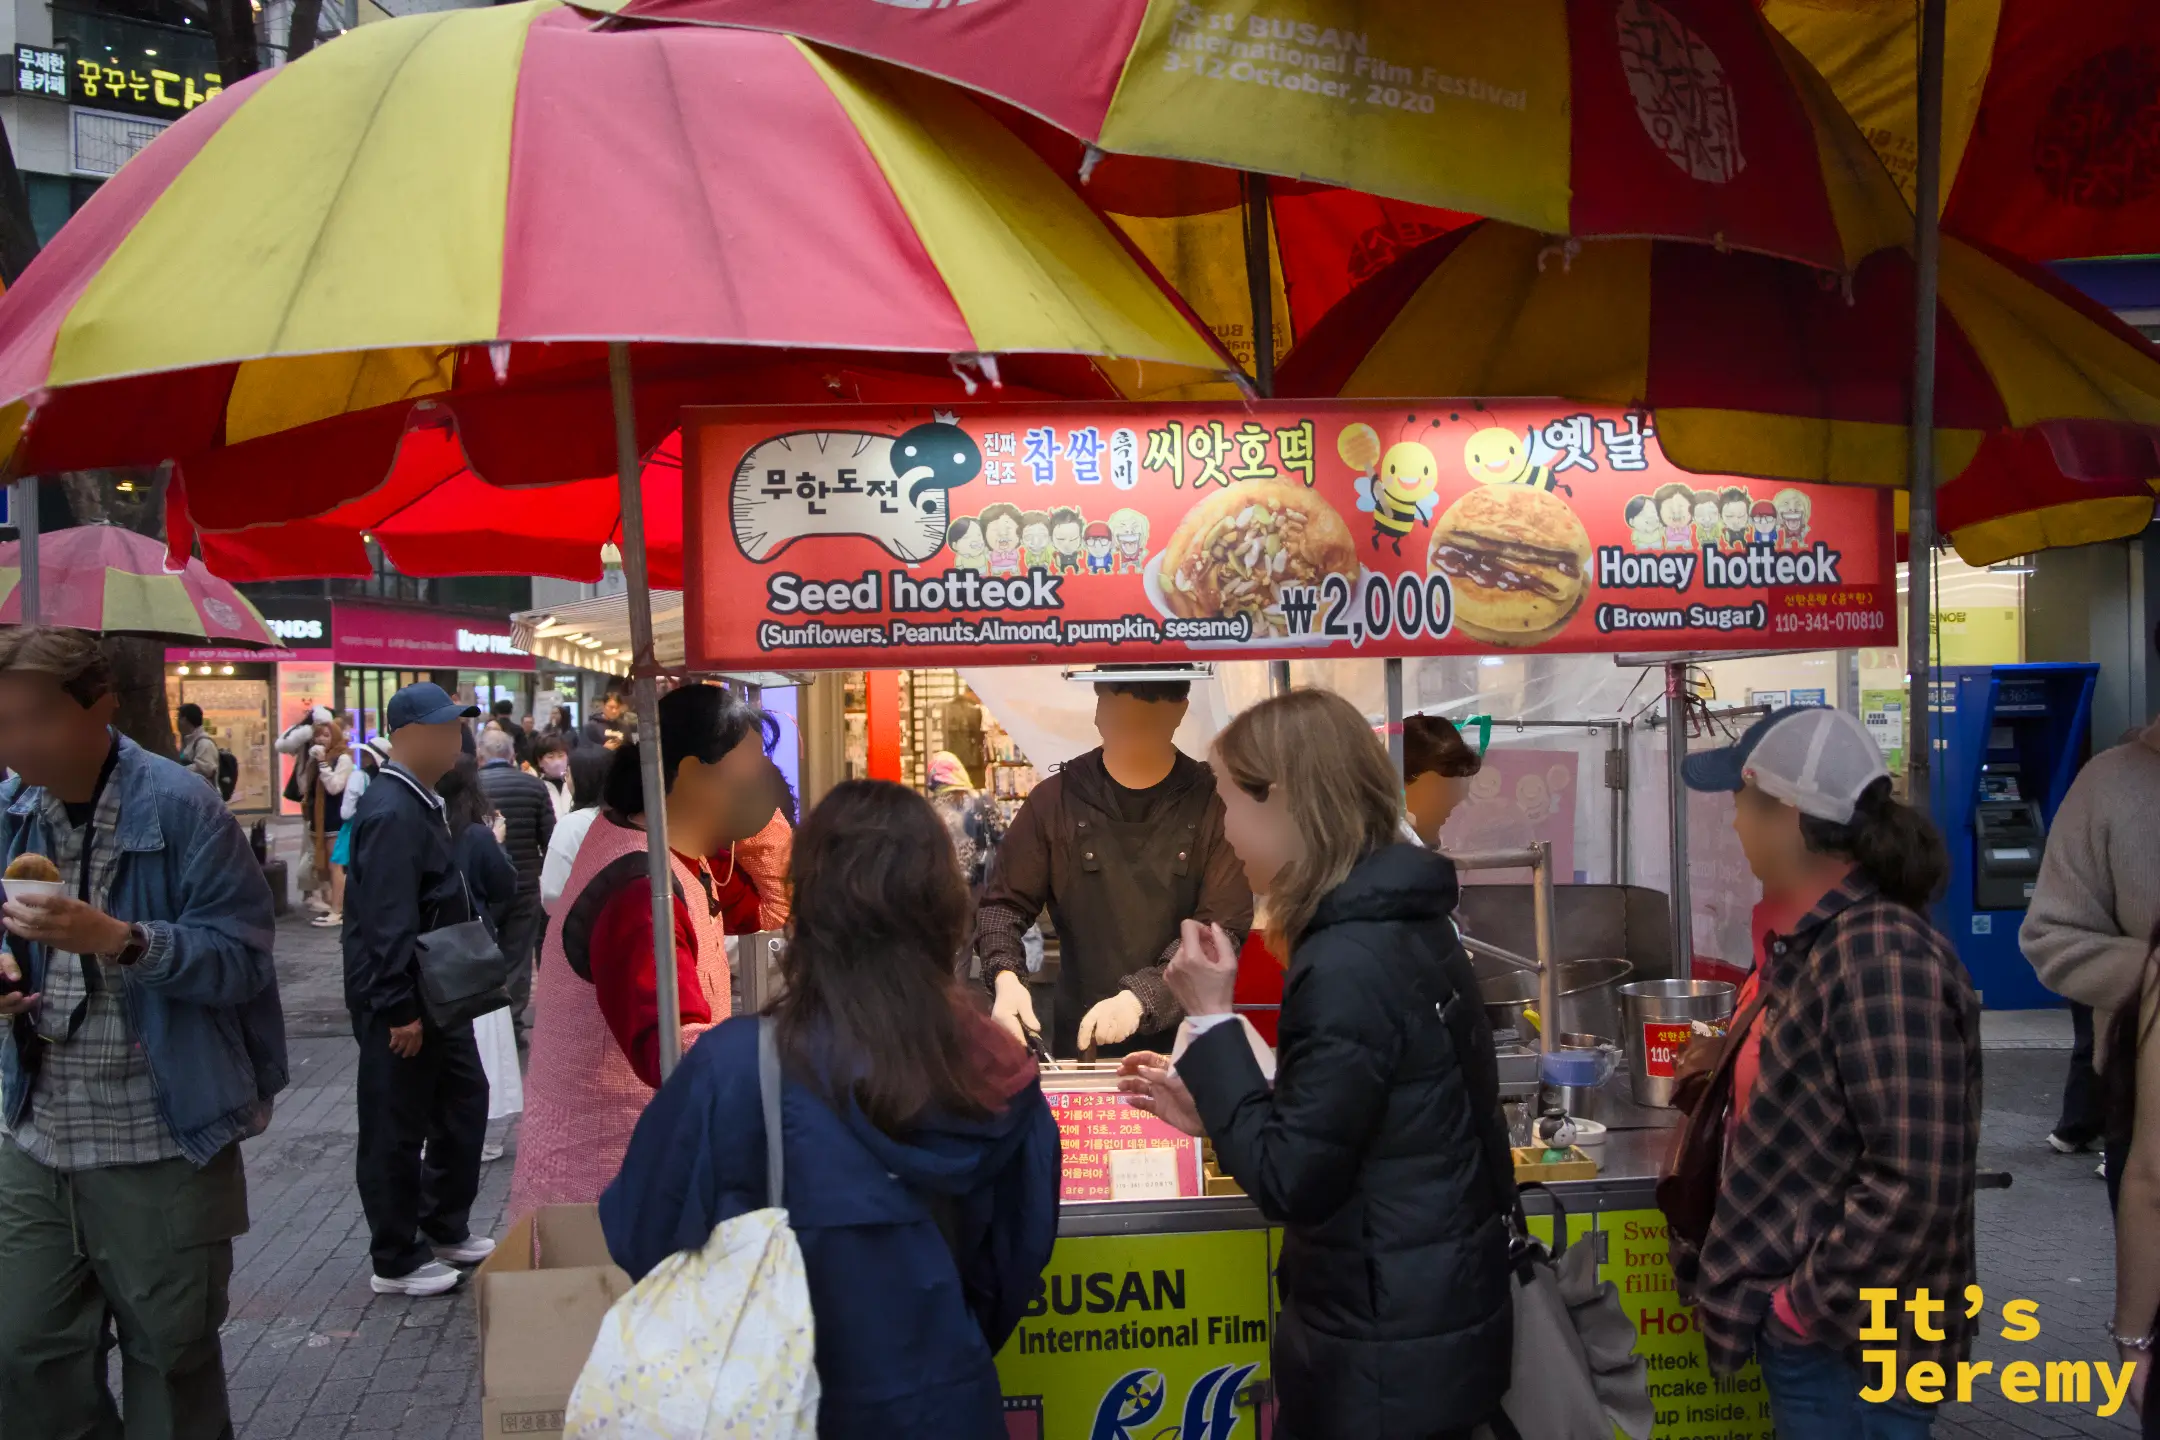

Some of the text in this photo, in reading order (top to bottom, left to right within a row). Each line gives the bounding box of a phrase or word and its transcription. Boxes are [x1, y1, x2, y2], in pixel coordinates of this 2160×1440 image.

[1247, 15, 1368, 55] BUSAN
[18, 47, 65, 74] 무제한
[1169, 22, 1528, 112] International Film Festival
[77, 59, 150, 102] 꿈꾸는
[1366, 84, 1435, 114] 2020
[983, 431, 1017, 457] 진짜
[1022, 419, 1317, 487] 찹쌀 흑미 씨앗호떡
[1543, 413, 1654, 471] 옛날
[984, 459, 1017, 486] 원조
[760, 467, 900, 515] 무한도전
[1600, 546, 1839, 588] Honey hotteok
[770, 571, 1061, 611] Seed hotteok
[1281, 574, 1453, 645] ₩2,000
[1775, 610, 1885, 633] 110-341-070810
[1067, 617, 1160, 642] pumpkin,
[1164, 614, 1249, 639] sesame)
[1650, 1046, 1677, 1063] 110-
[1063, 1109, 1093, 1121] 기름에
[1096, 1109, 1117, 1120] 구운
[1059, 1124, 1080, 1135] 지에
[1119, 1124, 1142, 1135] 20초
[1083, 1138, 1123, 1150] 기름없이
[1065, 1186, 1110, 1197] are pea
[1624, 1221, 1668, 1240] Swe
[1624, 1248, 1669, 1267] bro
[1020, 1269, 1186, 1317] BUSAN
[1019, 1315, 1267, 1354] International Film
[1640, 1307, 1702, 1335] Hot
[1647, 1351, 1700, 1370] tteok
[1647, 1378, 1708, 1398] ncake
